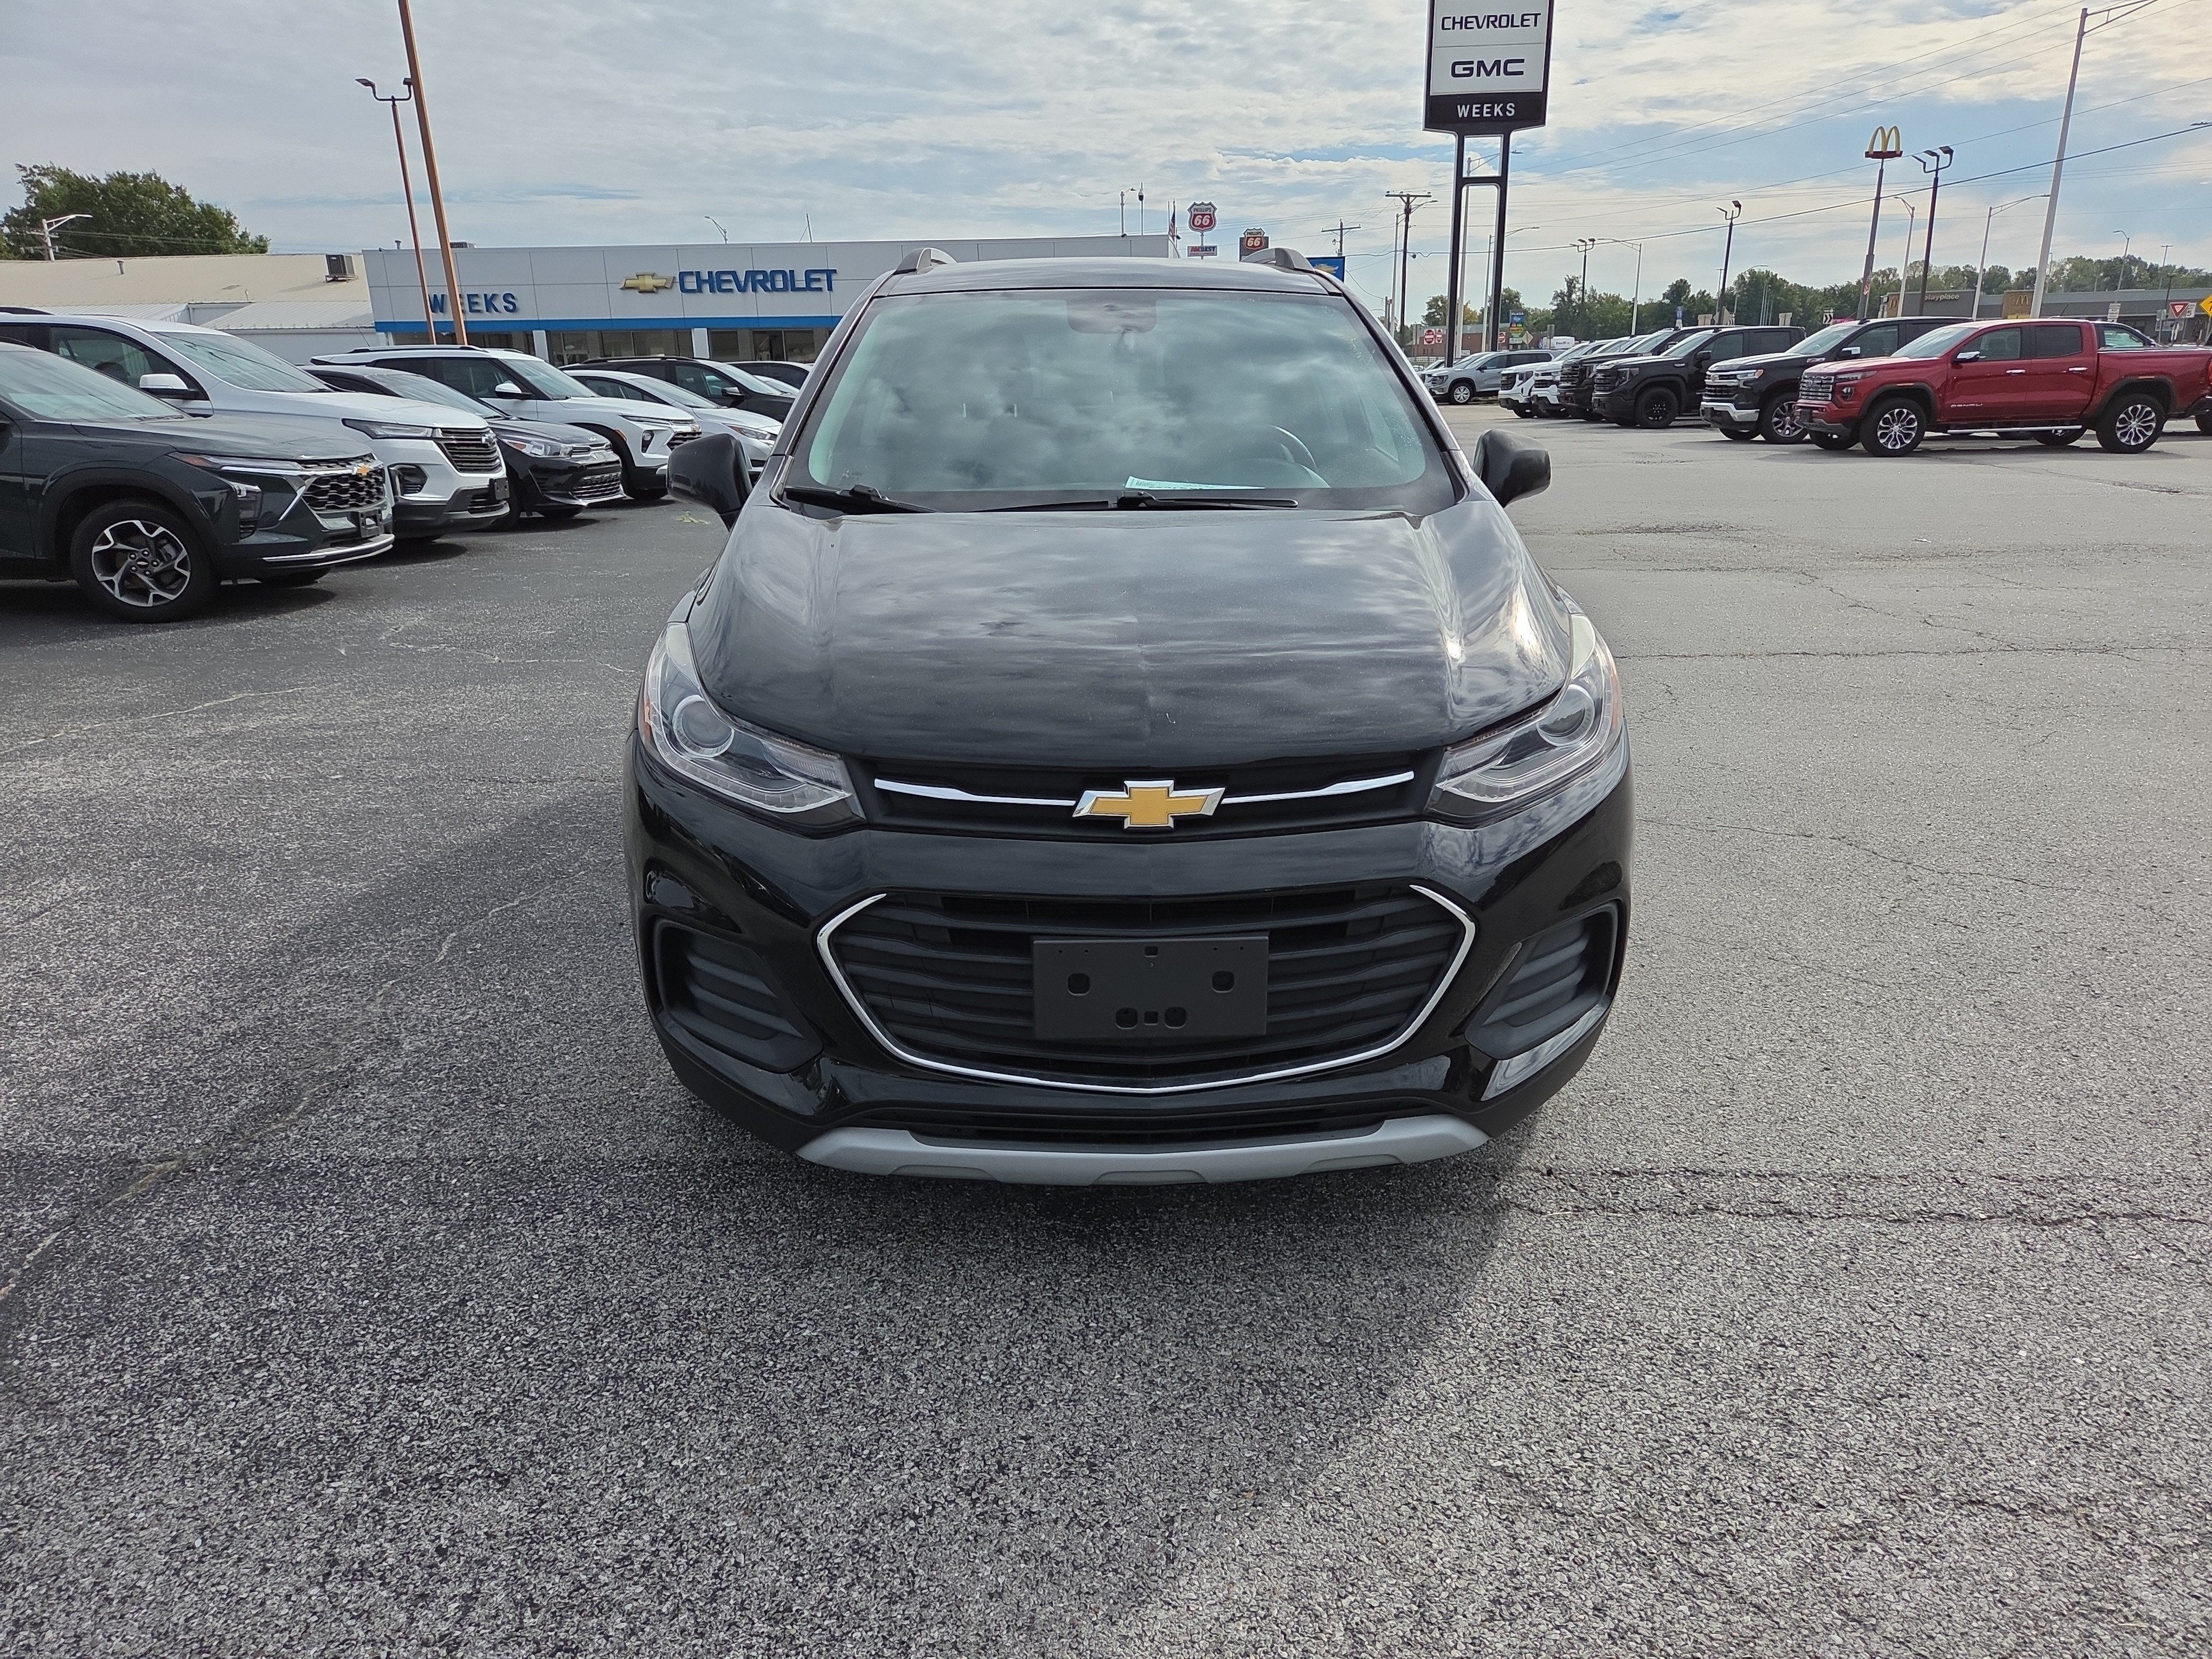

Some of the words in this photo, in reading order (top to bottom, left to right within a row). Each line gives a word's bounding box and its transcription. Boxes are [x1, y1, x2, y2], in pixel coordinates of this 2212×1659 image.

[1441, 13, 1541, 30] CHEVROLET
[1451, 59, 1525, 78] GMC
[1457, 103, 1515, 118] WEEKS
[1194, 215, 1211, 226] 66
[1247, 237, 1261, 247] 66
[679, 269, 837, 293] CHEVROLET
[428, 293, 517, 313] WEKS
